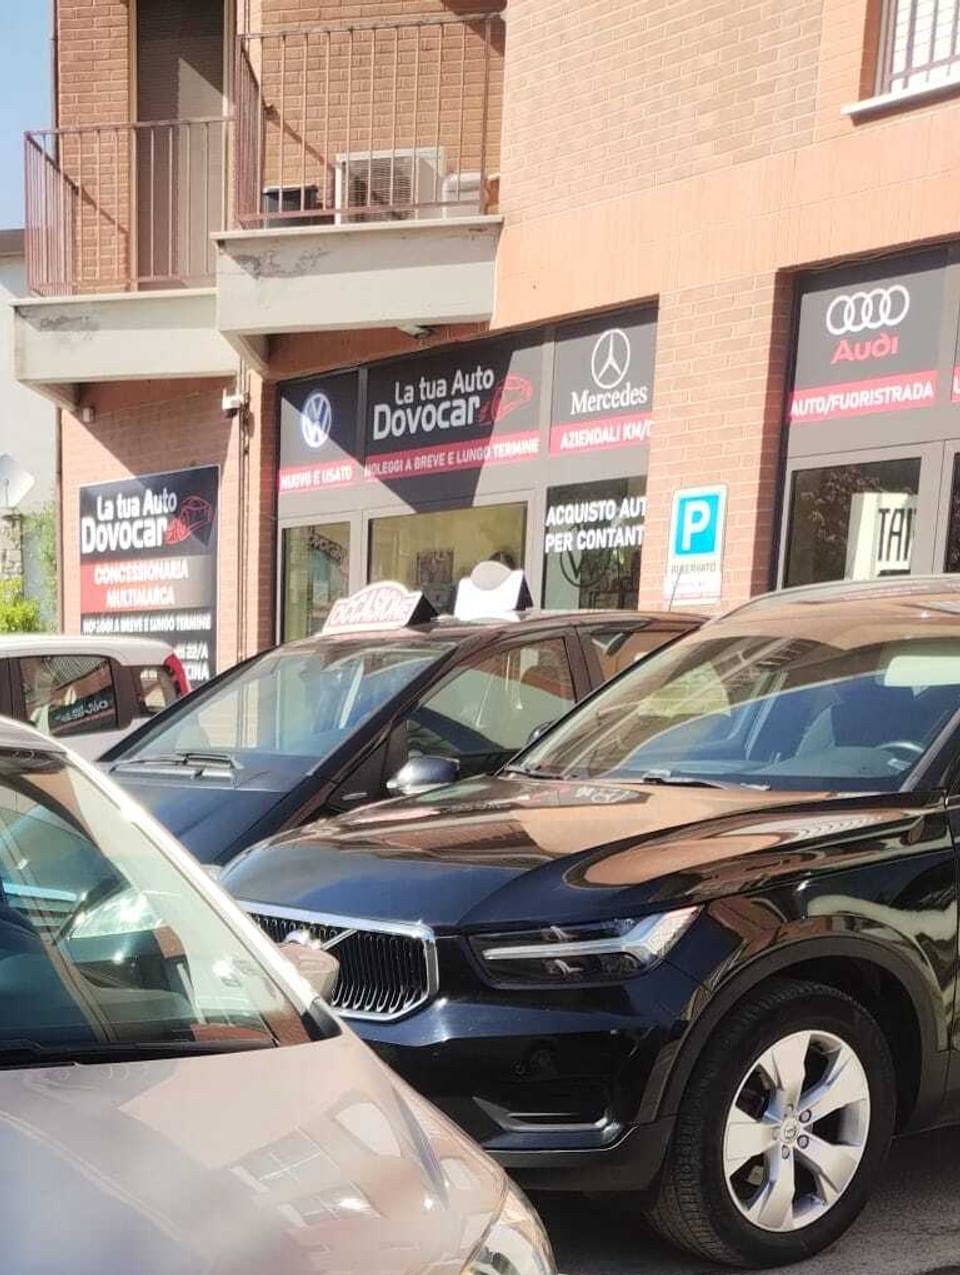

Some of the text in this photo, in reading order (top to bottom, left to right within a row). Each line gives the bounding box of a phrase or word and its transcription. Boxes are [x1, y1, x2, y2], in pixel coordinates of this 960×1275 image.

[831, 333, 899, 364] Audi
[395, 367, 495, 405] La tua Auto
[571, 382, 649, 415] Mercedes
[791, 381, 934, 417] AUTO/FUORISTRADA
[372, 396, 480, 440] Dovocar
[560, 425, 620, 449] AZIENDALI
[405, 461, 412, 472] A
[414, 454, 446, 471] BREVE
[448, 451, 456, 465] E
[457, 445, 490, 464] LUNGO
[493, 437, 539, 457] TERMINE
[281, 465, 353, 489] NUOVO E USATO
[97, 488, 177, 520] La tua Auto
[546, 500, 616, 527] ACQUISTO
[81, 516, 167, 553] Dovocar
[682, 500, 711, 551] P
[545, 531, 573, 553] PER
[94, 558, 189, 585] CONCESSIONARIA
